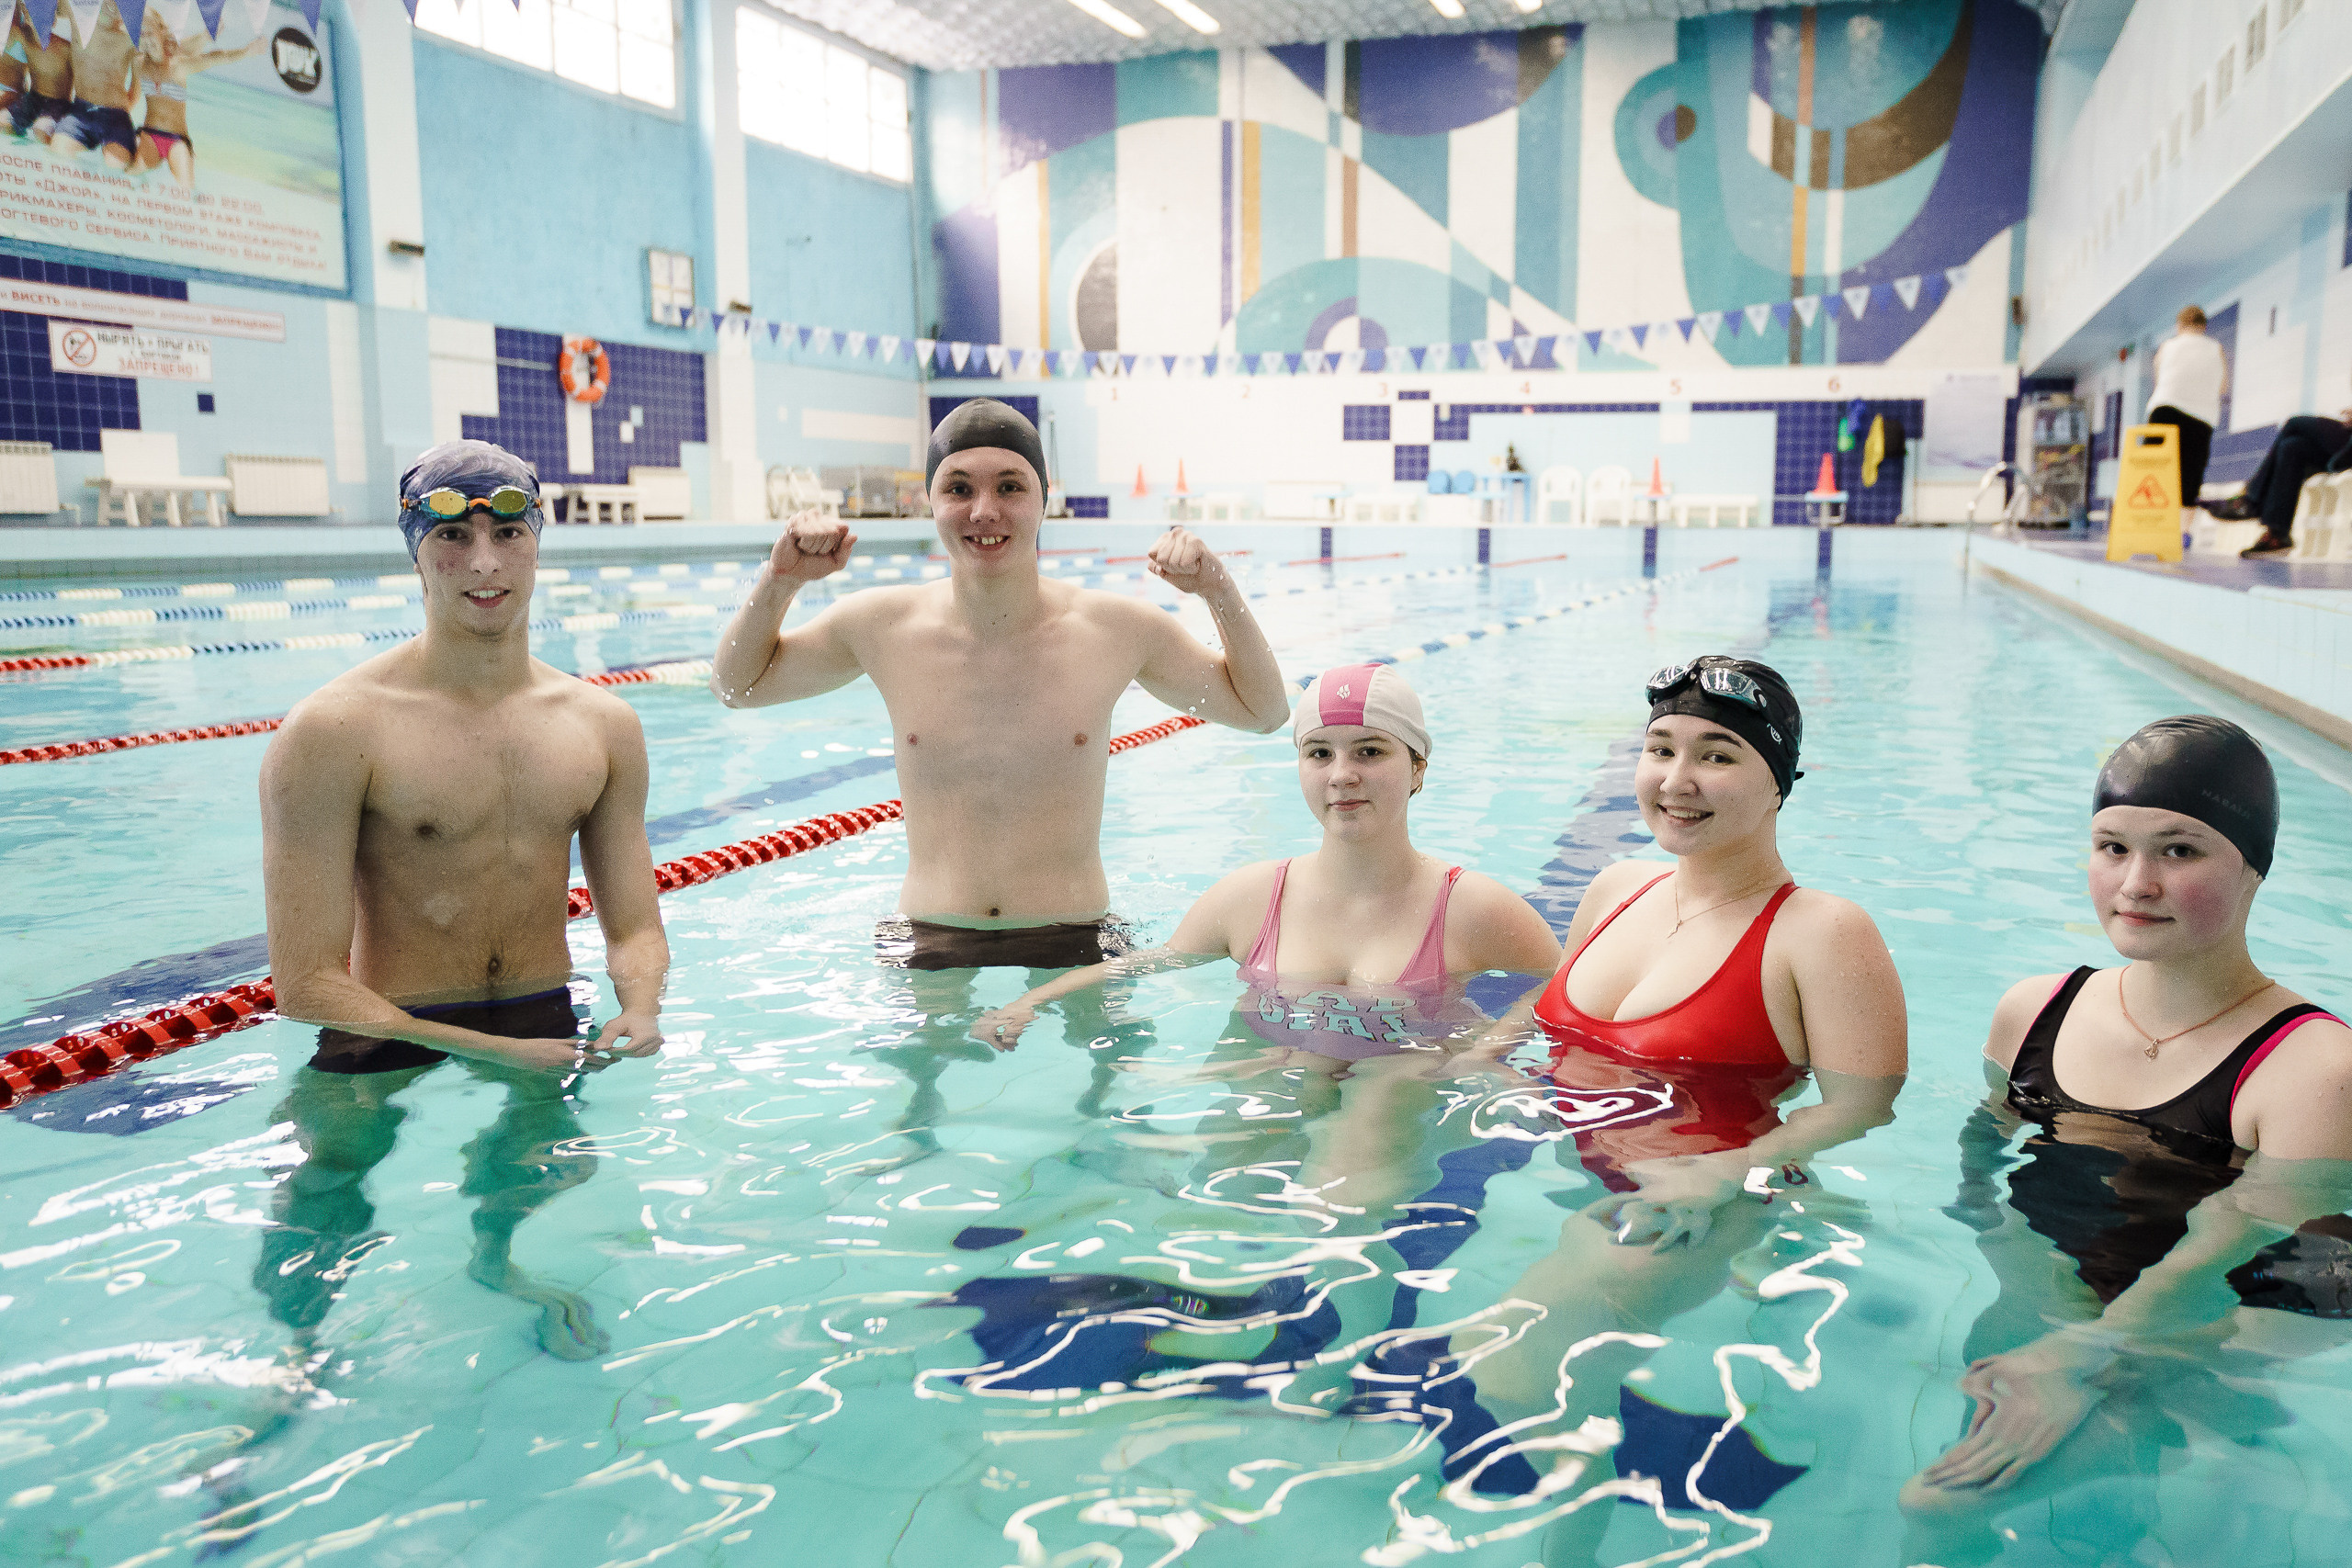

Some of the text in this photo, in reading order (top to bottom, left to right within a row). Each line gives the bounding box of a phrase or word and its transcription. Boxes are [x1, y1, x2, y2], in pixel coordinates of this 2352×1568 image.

[0, 153, 43, 172] ОСЛЕ
[137, 197, 193, 217] ПЕРВОМ
[12, 289, 61, 307] ВИСЕТЬ
[1670, 378, 1682, 396] 5
[1828, 375, 1841, 393] 6
